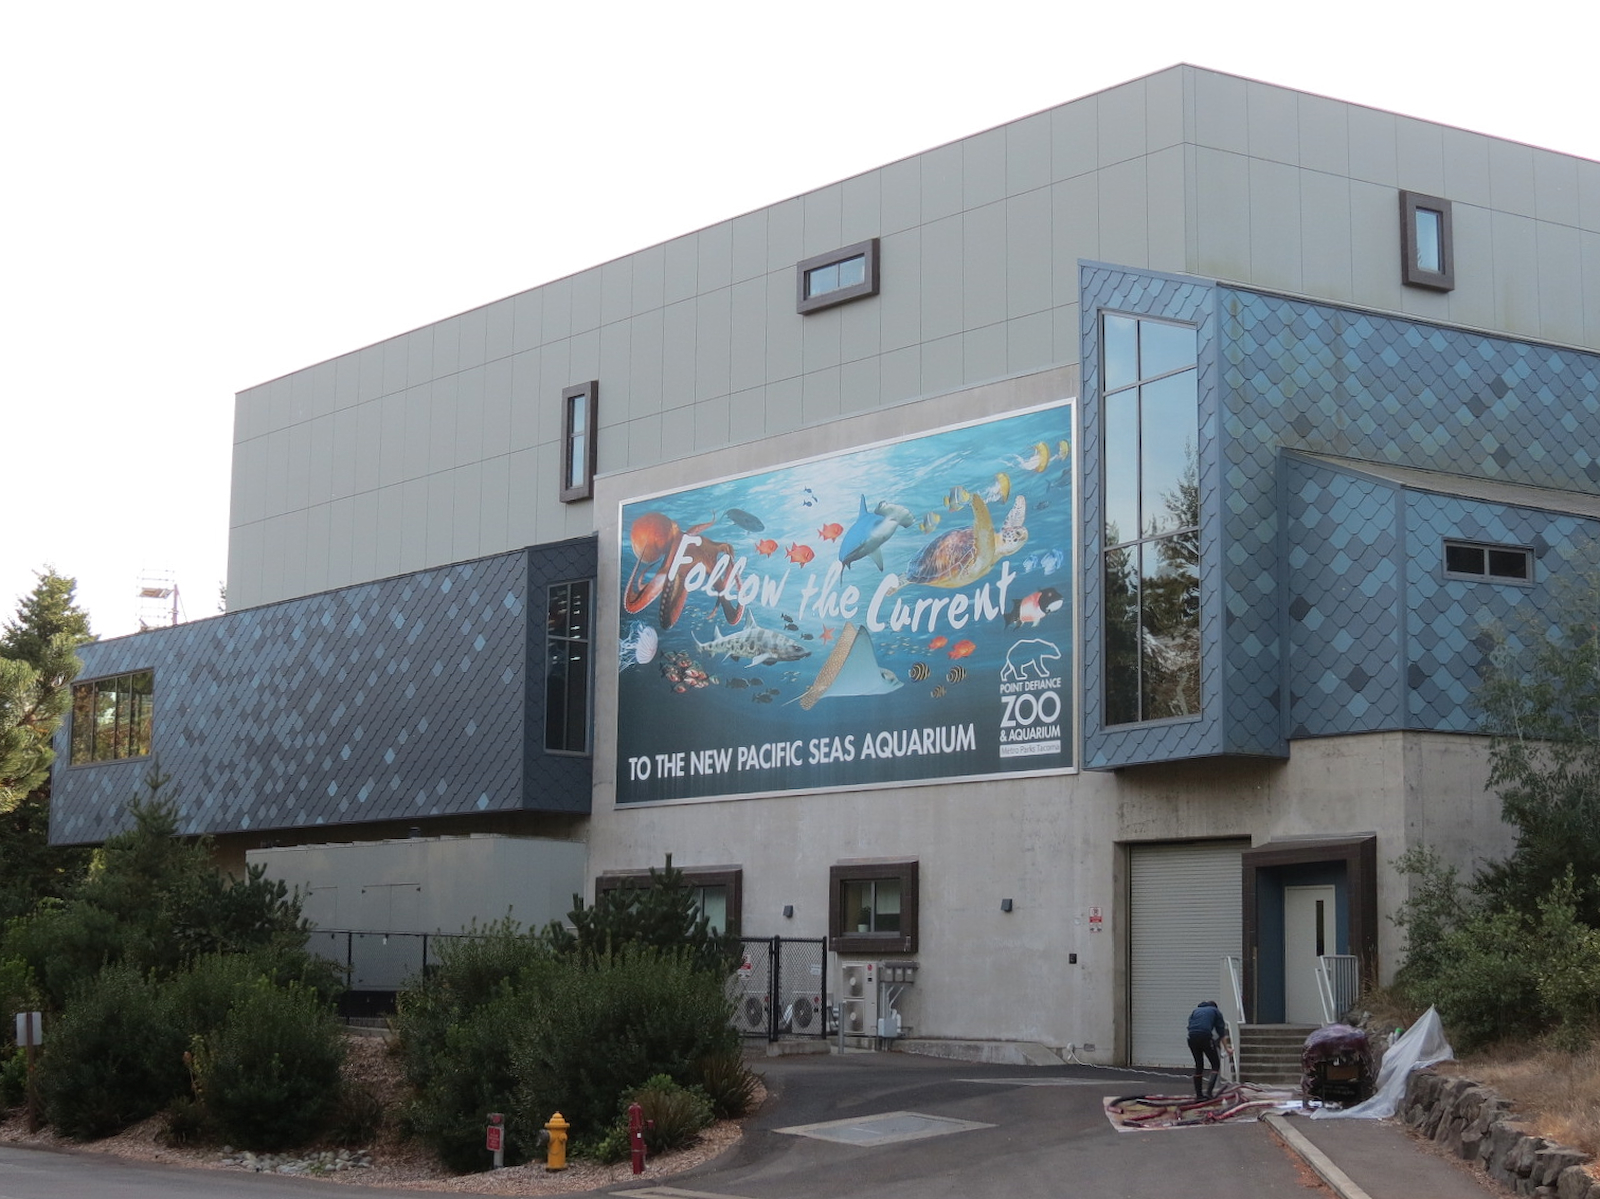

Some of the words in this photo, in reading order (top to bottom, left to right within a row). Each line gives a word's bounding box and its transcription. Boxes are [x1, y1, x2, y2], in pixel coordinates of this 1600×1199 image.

[668, 534, 790, 607] Follow
[799, 560, 860, 620] the
[866, 560, 1017, 633] Current
[1000, 682, 1023, 694] POINT
[1025, 677, 1061, 691] DEFIANCE
[1000, 691, 1061, 728] ZOO
[1000, 729, 1008, 742] &
[1008, 724, 1060, 742] AQUARIUM
[628, 755, 651, 781] TO
[655, 752, 685, 778] THE
[690, 748, 733, 776] NEW
[737, 740, 803, 771] PACIFIC
[808, 734, 855, 765] SEAS
[860, 723, 976, 760] AQUARIUM
